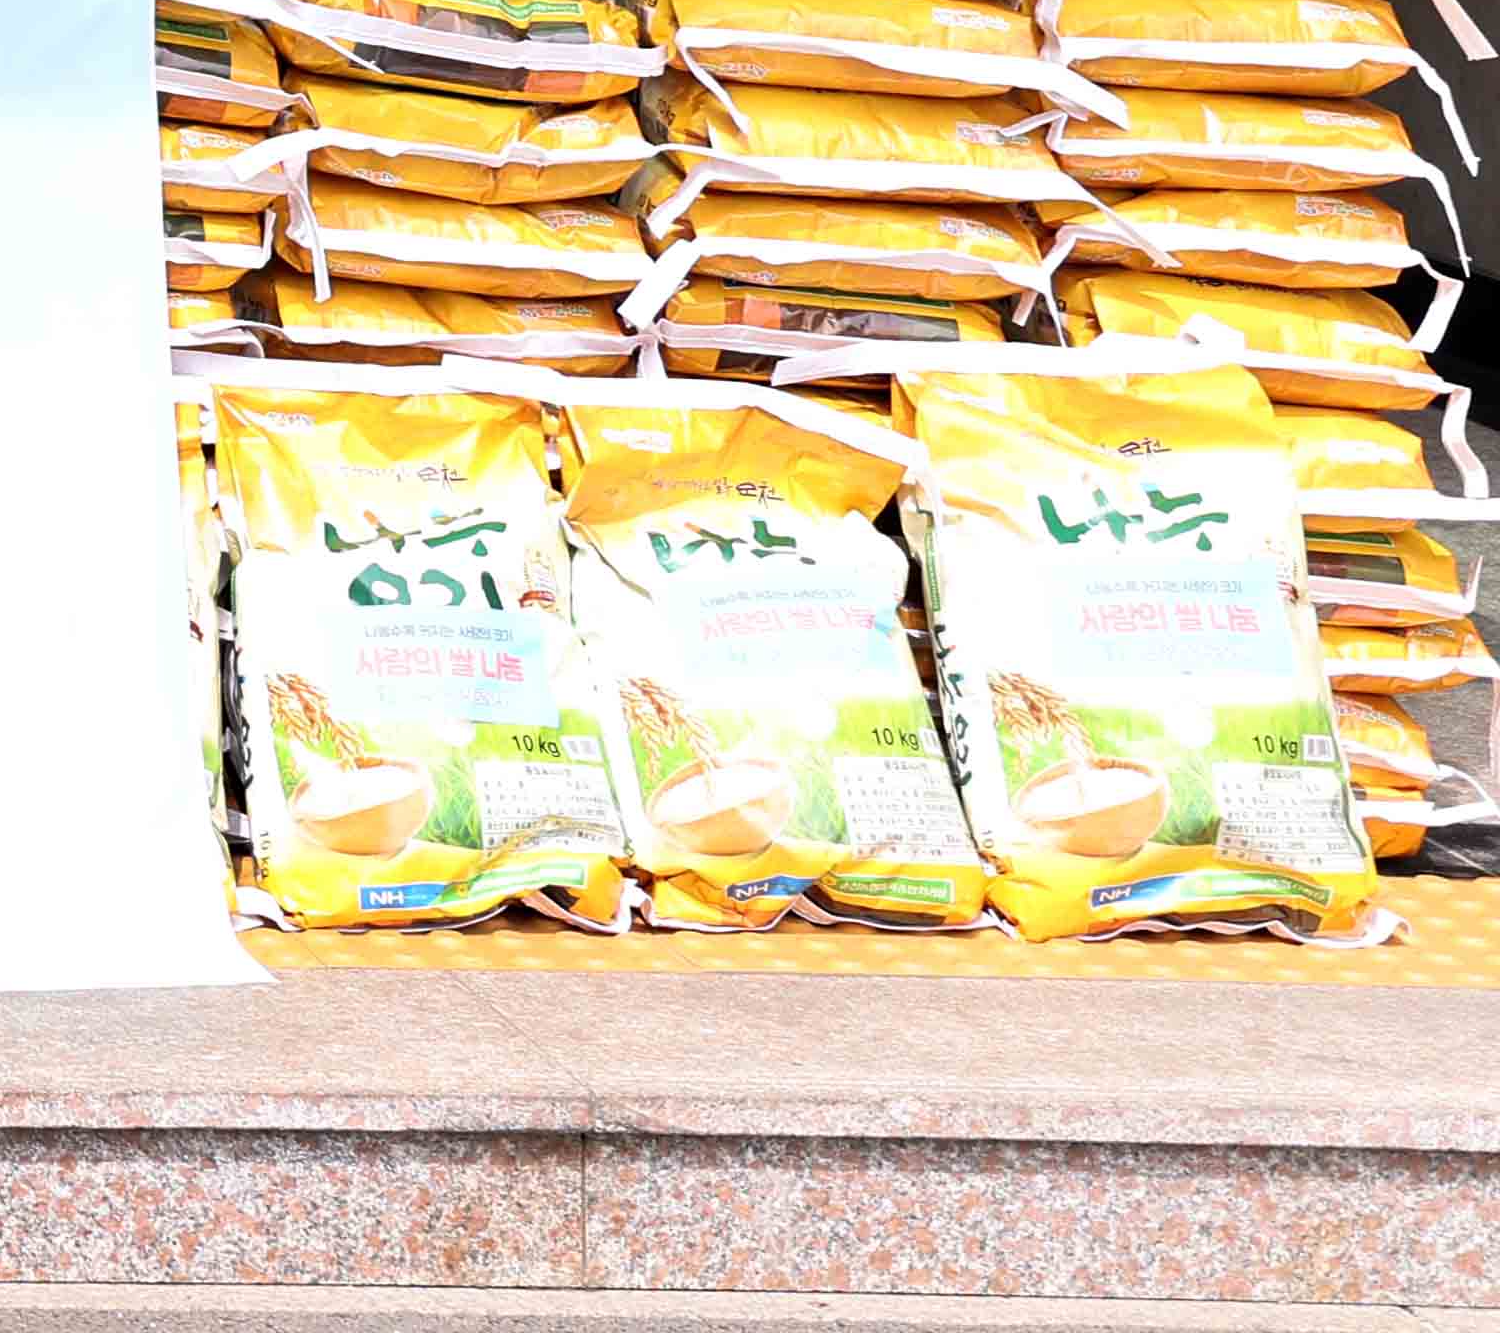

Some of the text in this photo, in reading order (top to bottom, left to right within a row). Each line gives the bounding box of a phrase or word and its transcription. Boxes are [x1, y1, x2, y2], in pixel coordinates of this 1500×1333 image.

[355, 645, 525, 682] 사랑의 쌀 나눔
[512, 734, 561, 757] 10 kg
[871, 727, 919, 751] 10 kg
[1252, 734, 1298, 758] 10 kg
[370, 892, 404, 905] NH
[736, 884, 768, 898] NH
[1100, 887, 1131, 901] NH
